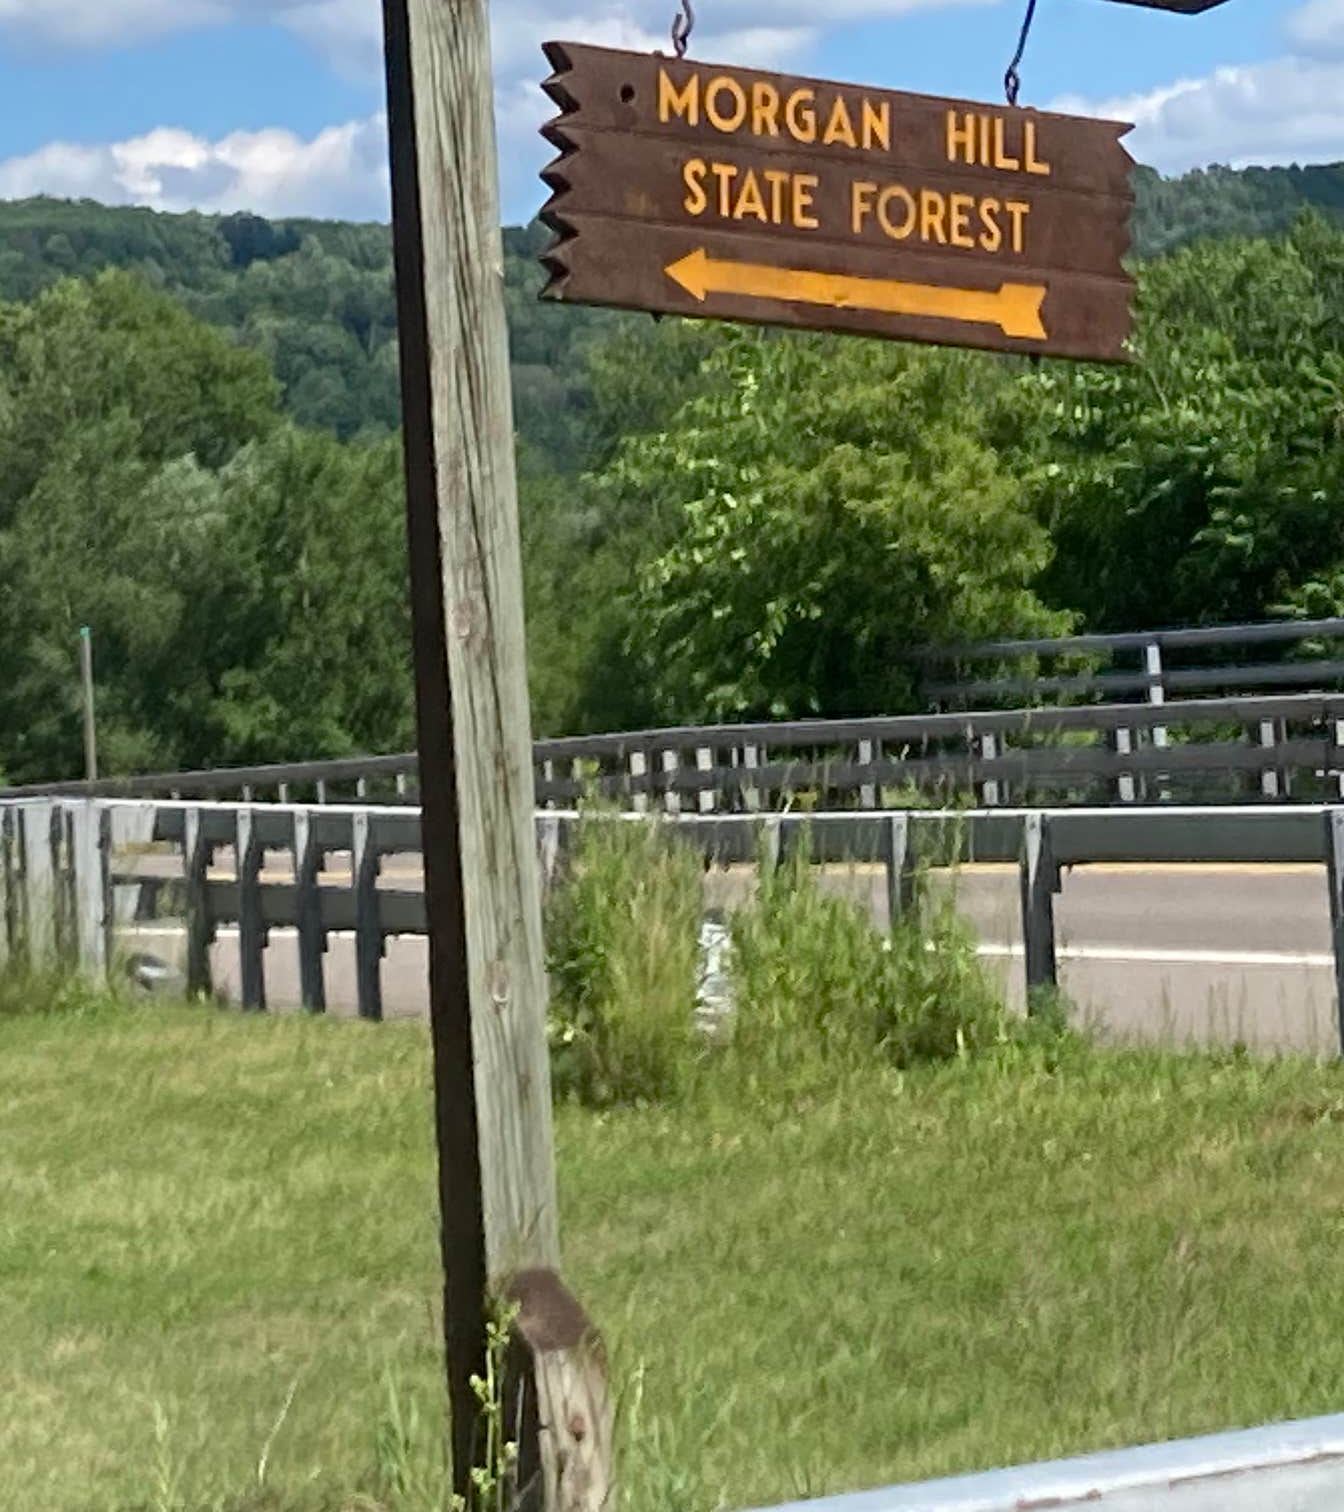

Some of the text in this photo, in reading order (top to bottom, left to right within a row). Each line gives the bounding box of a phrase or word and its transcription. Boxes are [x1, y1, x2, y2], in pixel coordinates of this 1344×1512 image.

[659, 68, 1051, 175] MORGAN HILL
[683, 158, 1030, 253] STATE FOREST
